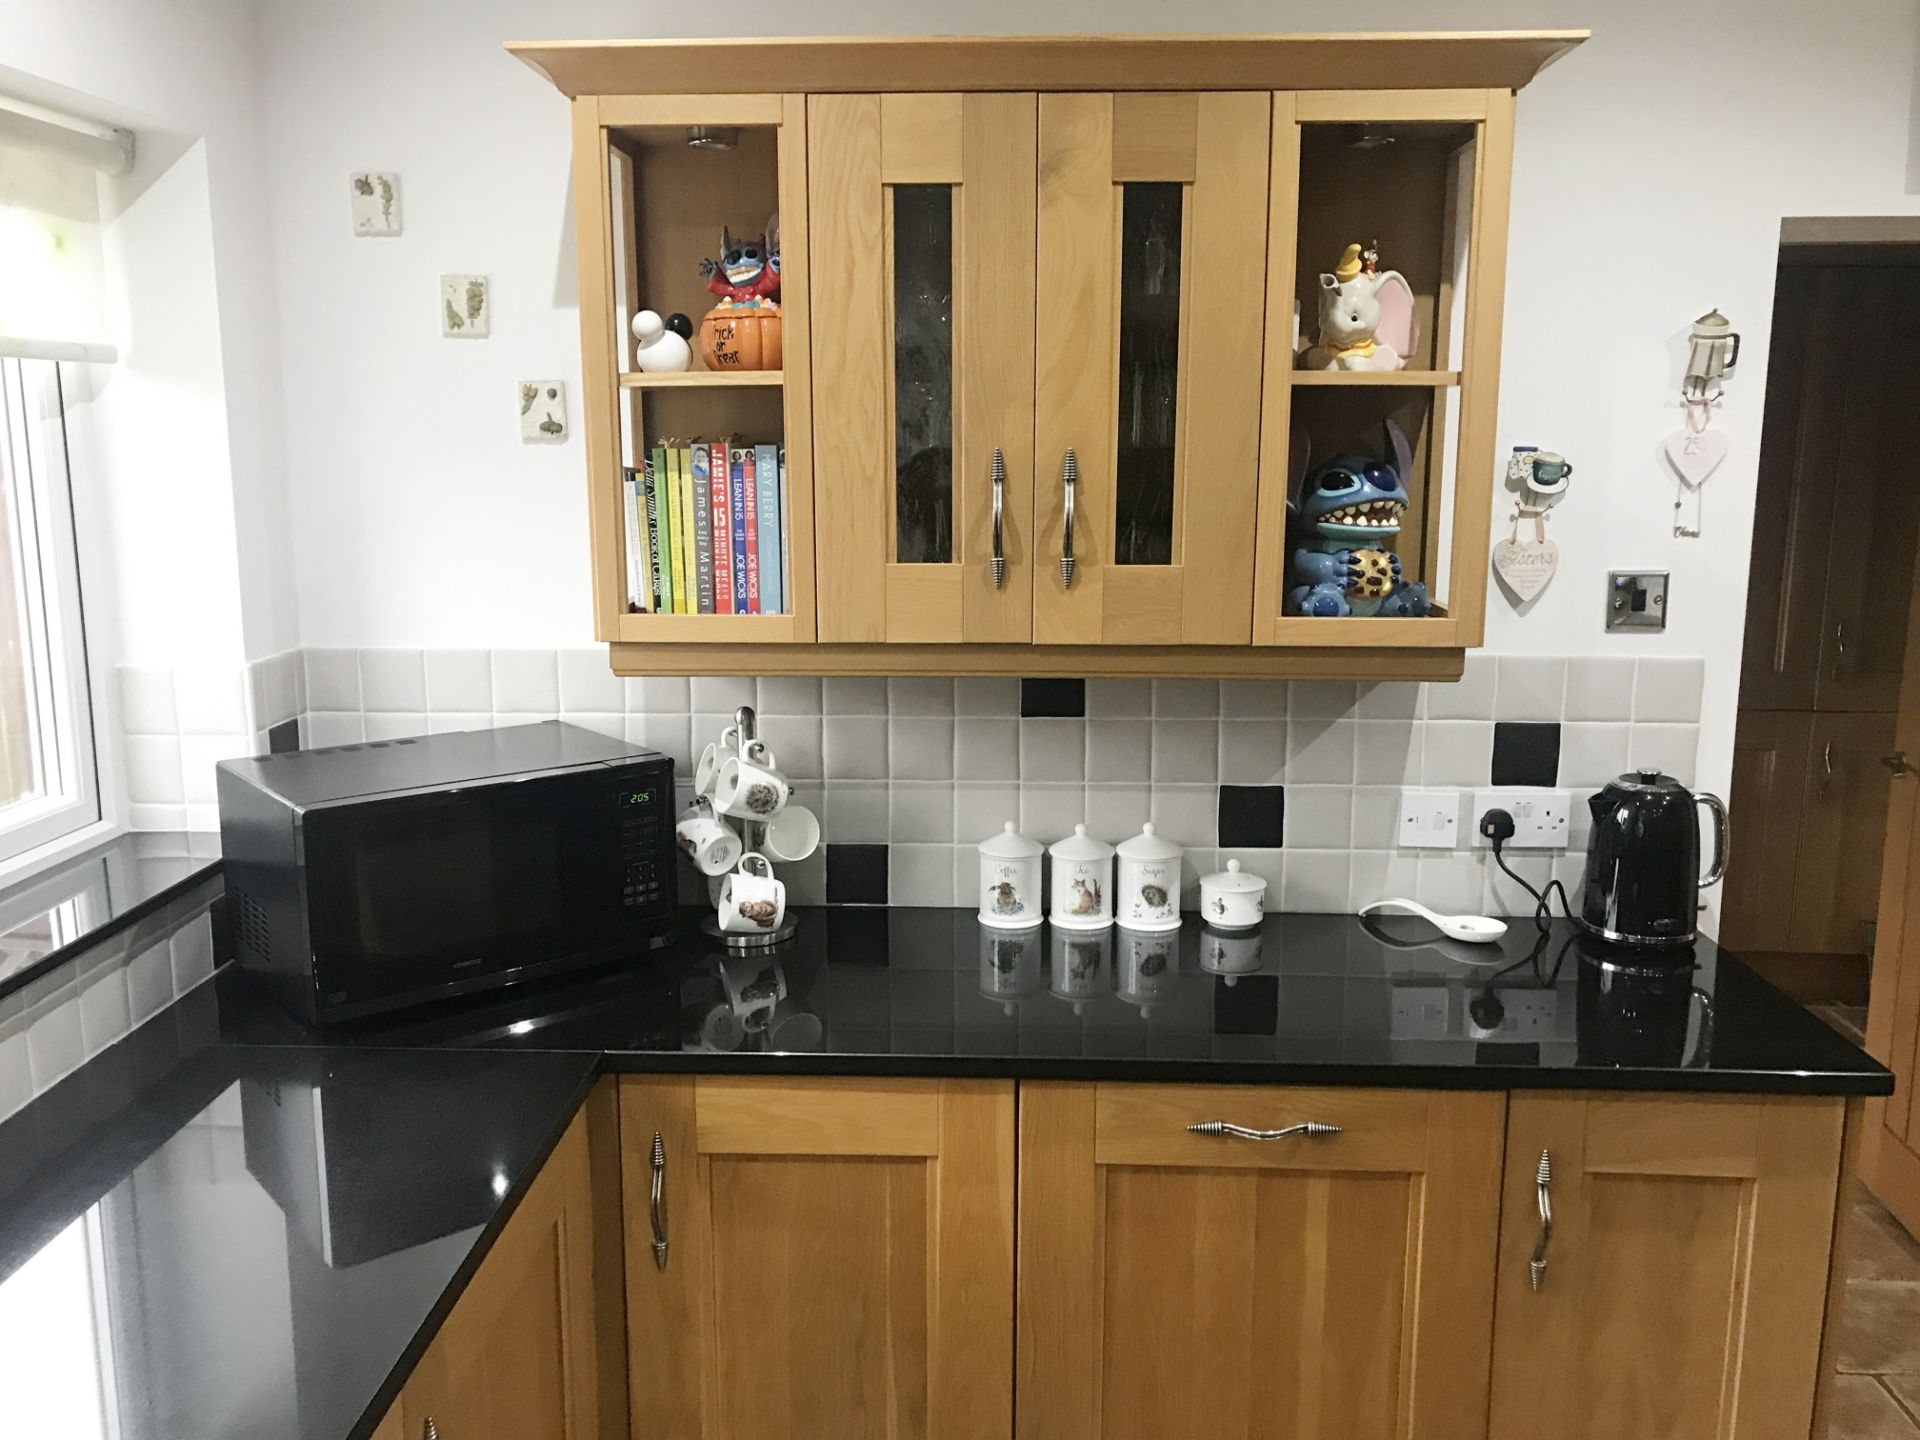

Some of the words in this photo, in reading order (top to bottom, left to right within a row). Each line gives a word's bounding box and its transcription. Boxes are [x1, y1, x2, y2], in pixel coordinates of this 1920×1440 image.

[716, 341, 726, 352] or
[712, 450, 725, 503] JAMIE'S
[762, 453, 773, 486] MARY
[694, 478, 707, 527] James
[733, 479, 743, 501] LEAN
[745, 479, 755, 501] LEAN
[714, 507, 726, 527] 15
[735, 501, 744, 511] IN
[735, 511, 744, 521] 15
[746, 501, 755, 511] IN
[746, 511, 756, 520] 15
[762, 490, 774, 527] BERRY
[650, 527, 659, 555] Book
[714, 529, 728, 566] MINUTE
[736, 552, 745, 570] JOE
[747, 552, 757, 569] JOE
[700, 551, 712, 606] Martin
[716, 569, 729, 600] MEALS
[737, 570, 747, 599] WICKS
[748, 570, 758, 599] WICKS
